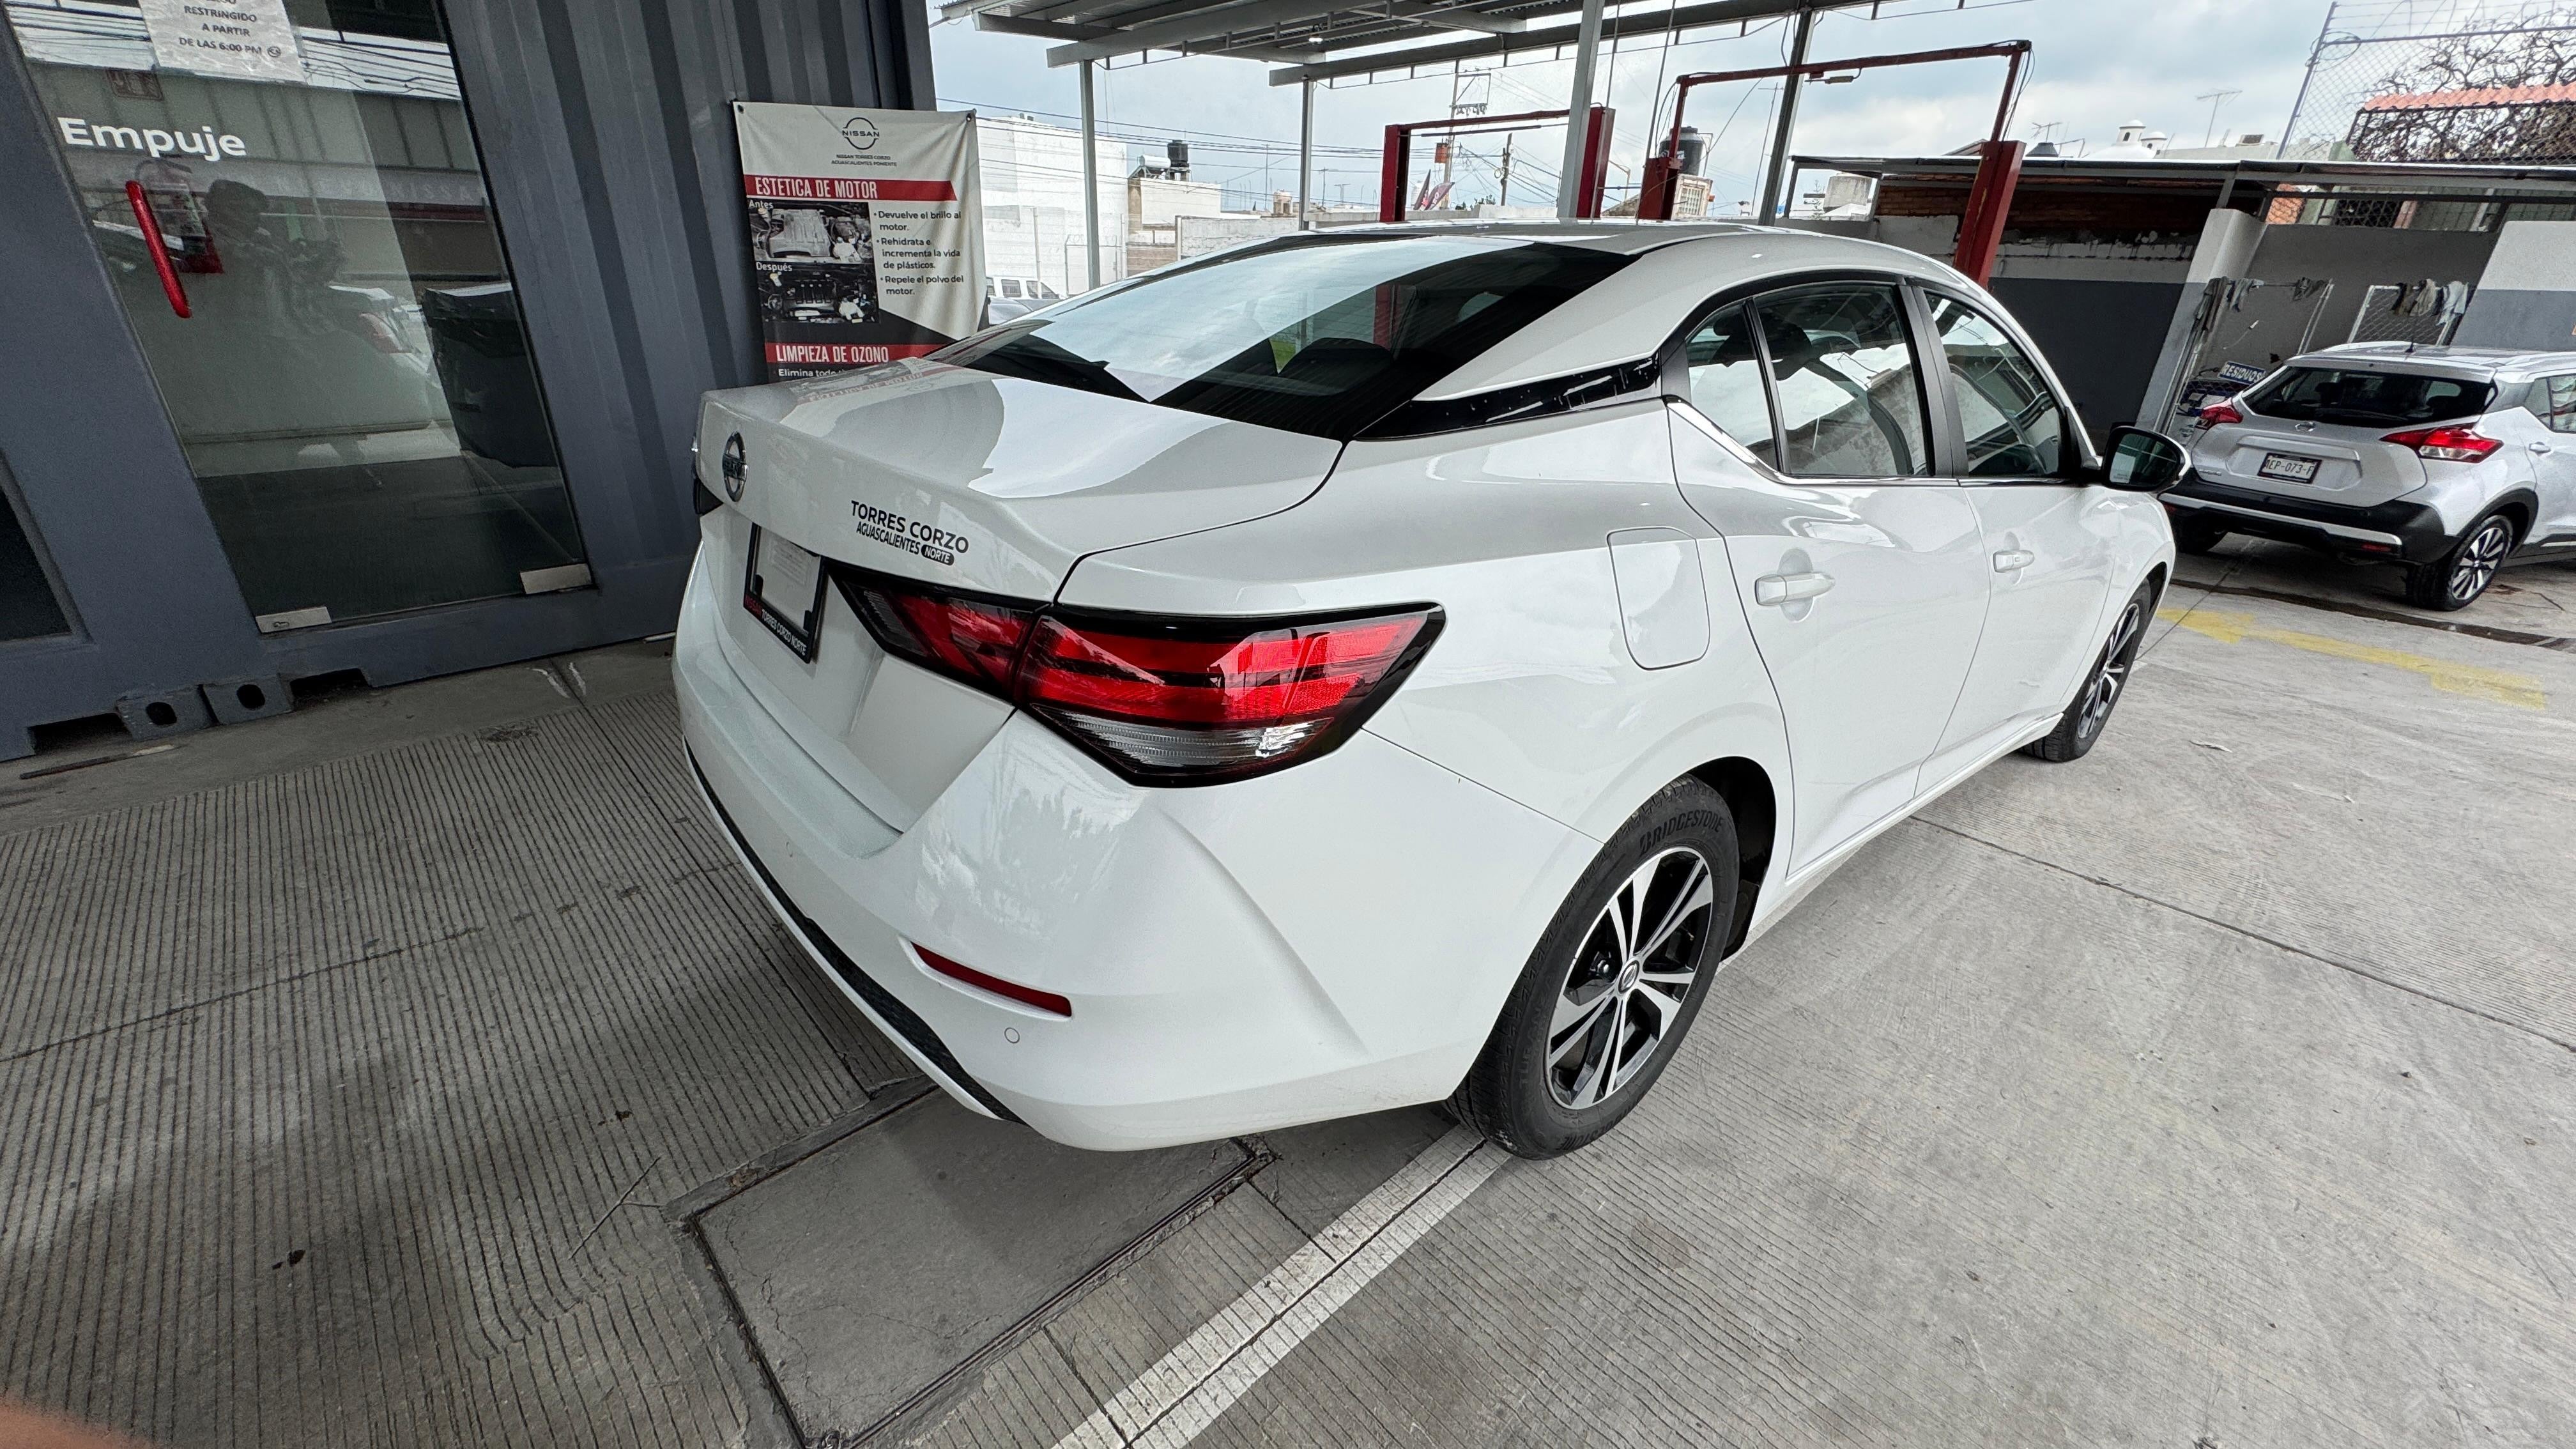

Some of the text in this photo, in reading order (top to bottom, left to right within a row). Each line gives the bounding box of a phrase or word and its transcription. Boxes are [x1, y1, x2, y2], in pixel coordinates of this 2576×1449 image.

[202, 23, 250, 36] A PARTIR
[179, 37, 194, 47] DE
[197, 40, 216, 49] LAS
[219, 42, 241, 52] 6:00
[57, 117, 247, 162] Empuje
[815, 180, 831, 197] DE
[834, 180, 878, 199] MOTOR
[749, 199, 774, 210] Antes
[882, 249, 932, 257] incrementa
[756, 262, 793, 273] Después
[885, 275, 915, 284] Repele
[926, 275, 949, 284] polvo
[776, 345, 889, 363] LIMPIEZA DE OZONO
[778, 369, 814, 377] Elimina
[2223, 364, 2262, 383] RESIDUOS
[851, 500, 969, 553] TORRES CORZO
[856, 521, 951, 564] AGUASCALIENTES NORTE
[790, 634, 808, 656] NORTE
[1639, 809, 1723, 857] BRIDGESTONE
